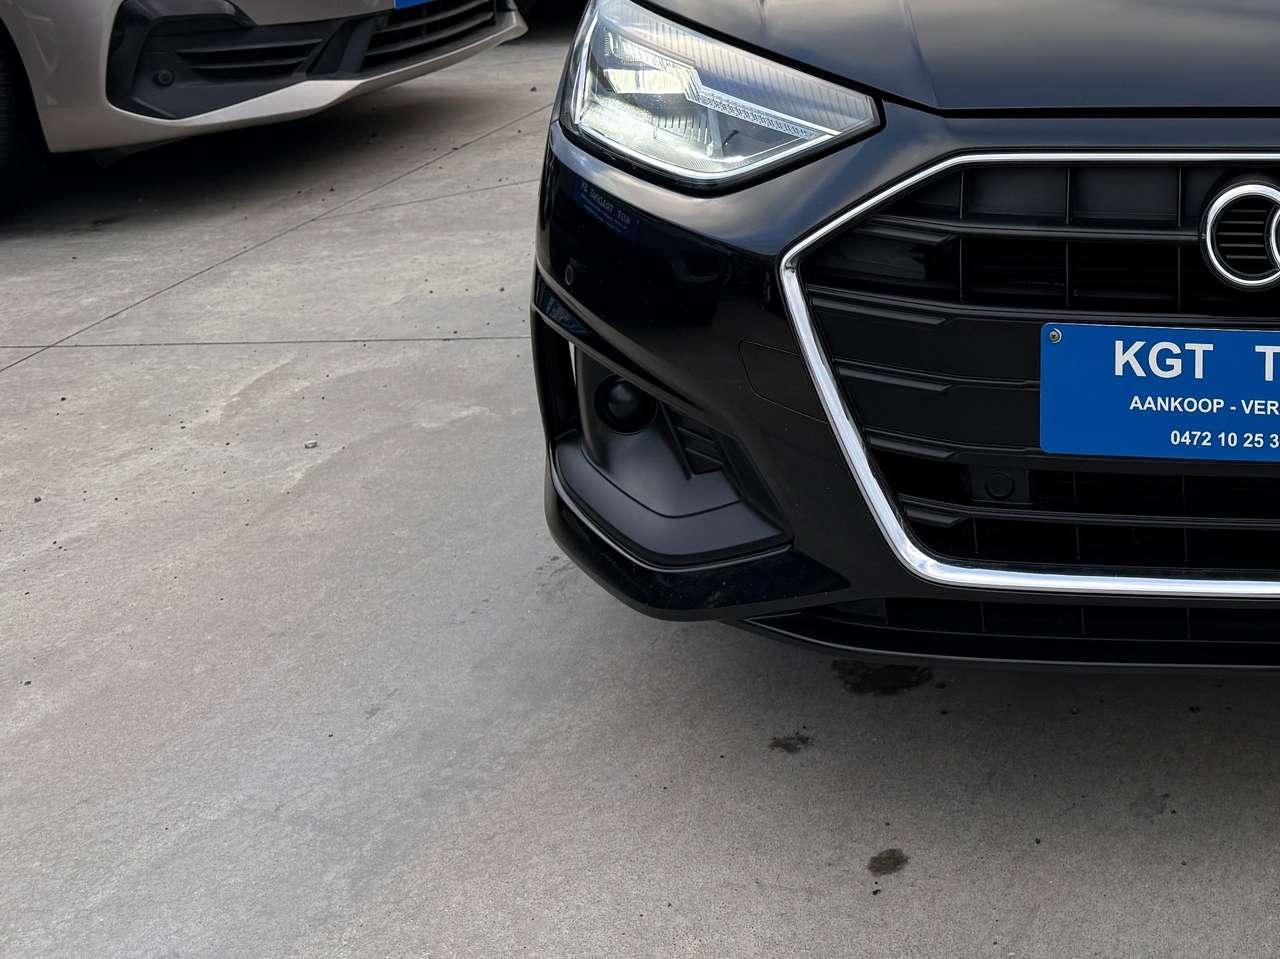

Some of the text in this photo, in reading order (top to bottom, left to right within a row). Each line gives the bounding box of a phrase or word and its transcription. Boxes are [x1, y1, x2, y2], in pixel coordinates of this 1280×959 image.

[1114, 339, 1214, 380] KGT
[1129, 395, 1225, 414] AANKOOP
[1170, 430, 1212, 447] 0472
[1218, 431, 1238, 448] 10
[1243, 432, 1264, 448] 25
